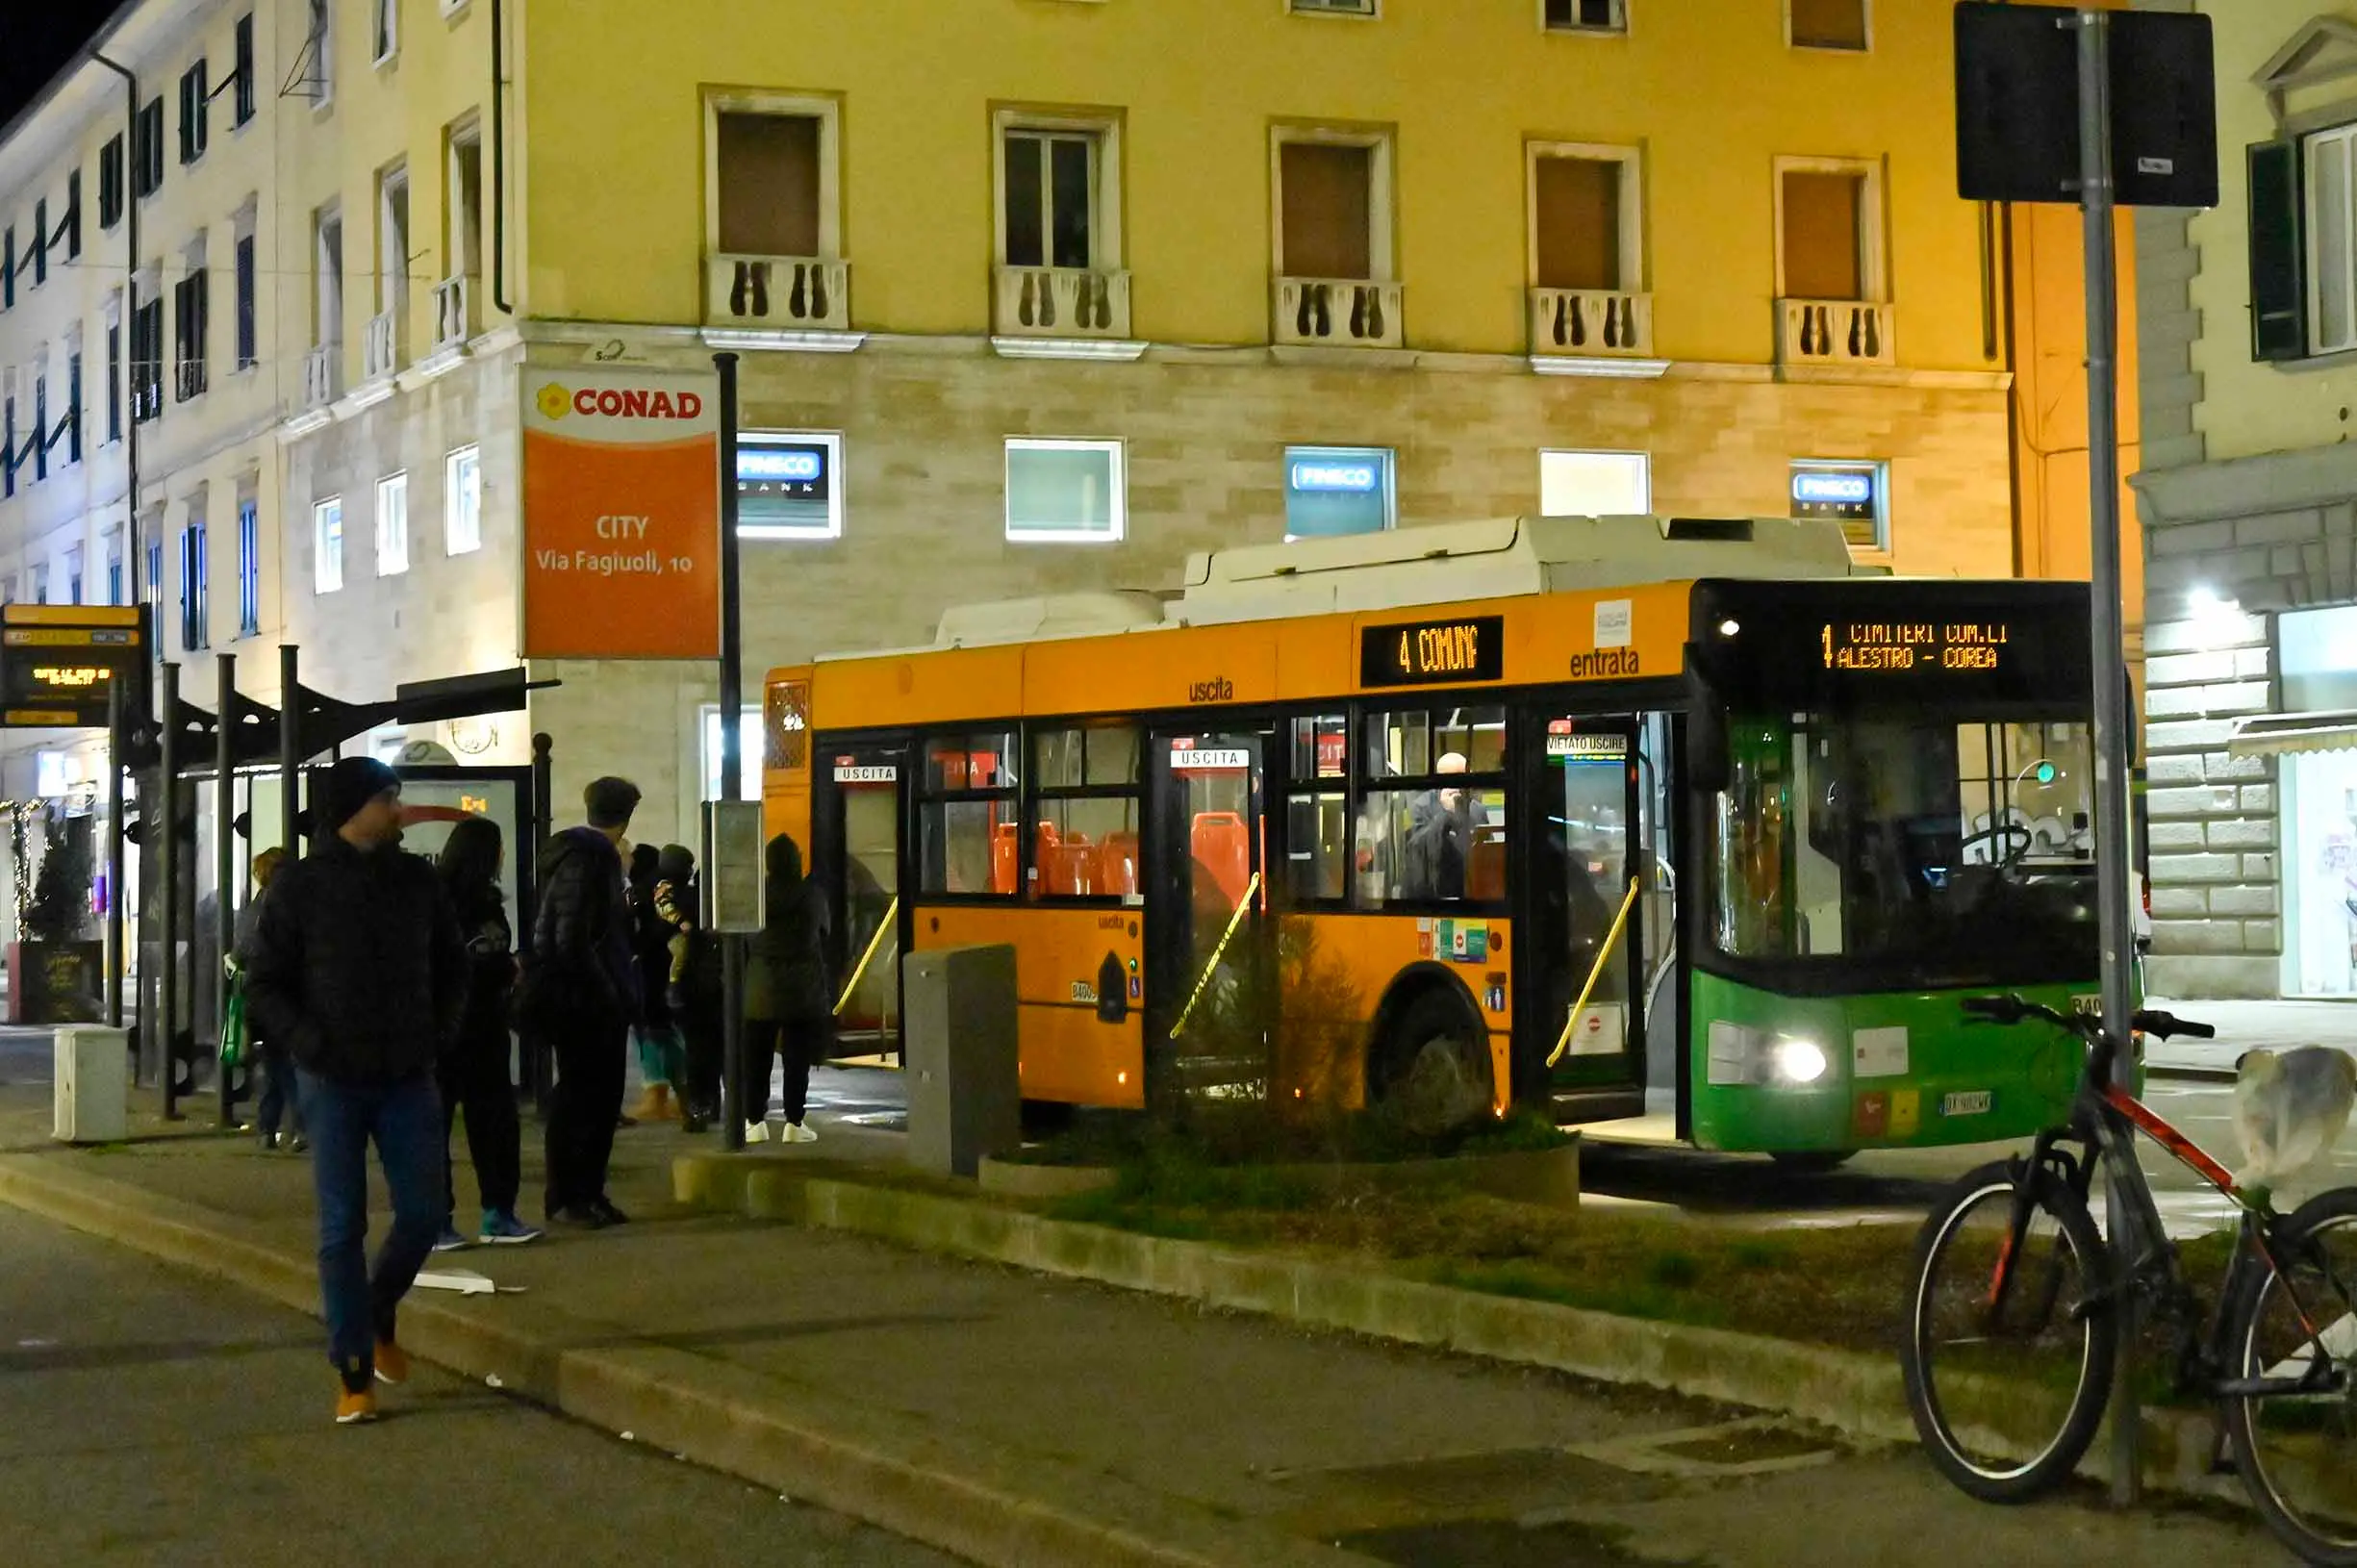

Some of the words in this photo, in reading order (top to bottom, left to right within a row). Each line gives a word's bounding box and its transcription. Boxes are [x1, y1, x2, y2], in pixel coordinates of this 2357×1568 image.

[573, 389, 701, 418] CONAD
[596, 516, 648, 539] CITY
[536, 549, 570, 570] Via
[575, 549, 662, 576] Fagiuoli,
[670, 556, 693, 572] 10
[1400, 630, 1410, 672] 4
[1822, 625, 1833, 668] 1
[1943, 647, 1997, 668] COREA
[1570, 646, 1639, 677] entrata
[1189, 676, 1233, 702] uscita
[1548, 737, 1587, 749] VIETATO
[1590, 737, 1626, 749] USCIRE
[1181, 752, 1239, 765] USCITA
[843, 769, 893, 779] USCITA
[1099, 915, 1125, 929] uscita
